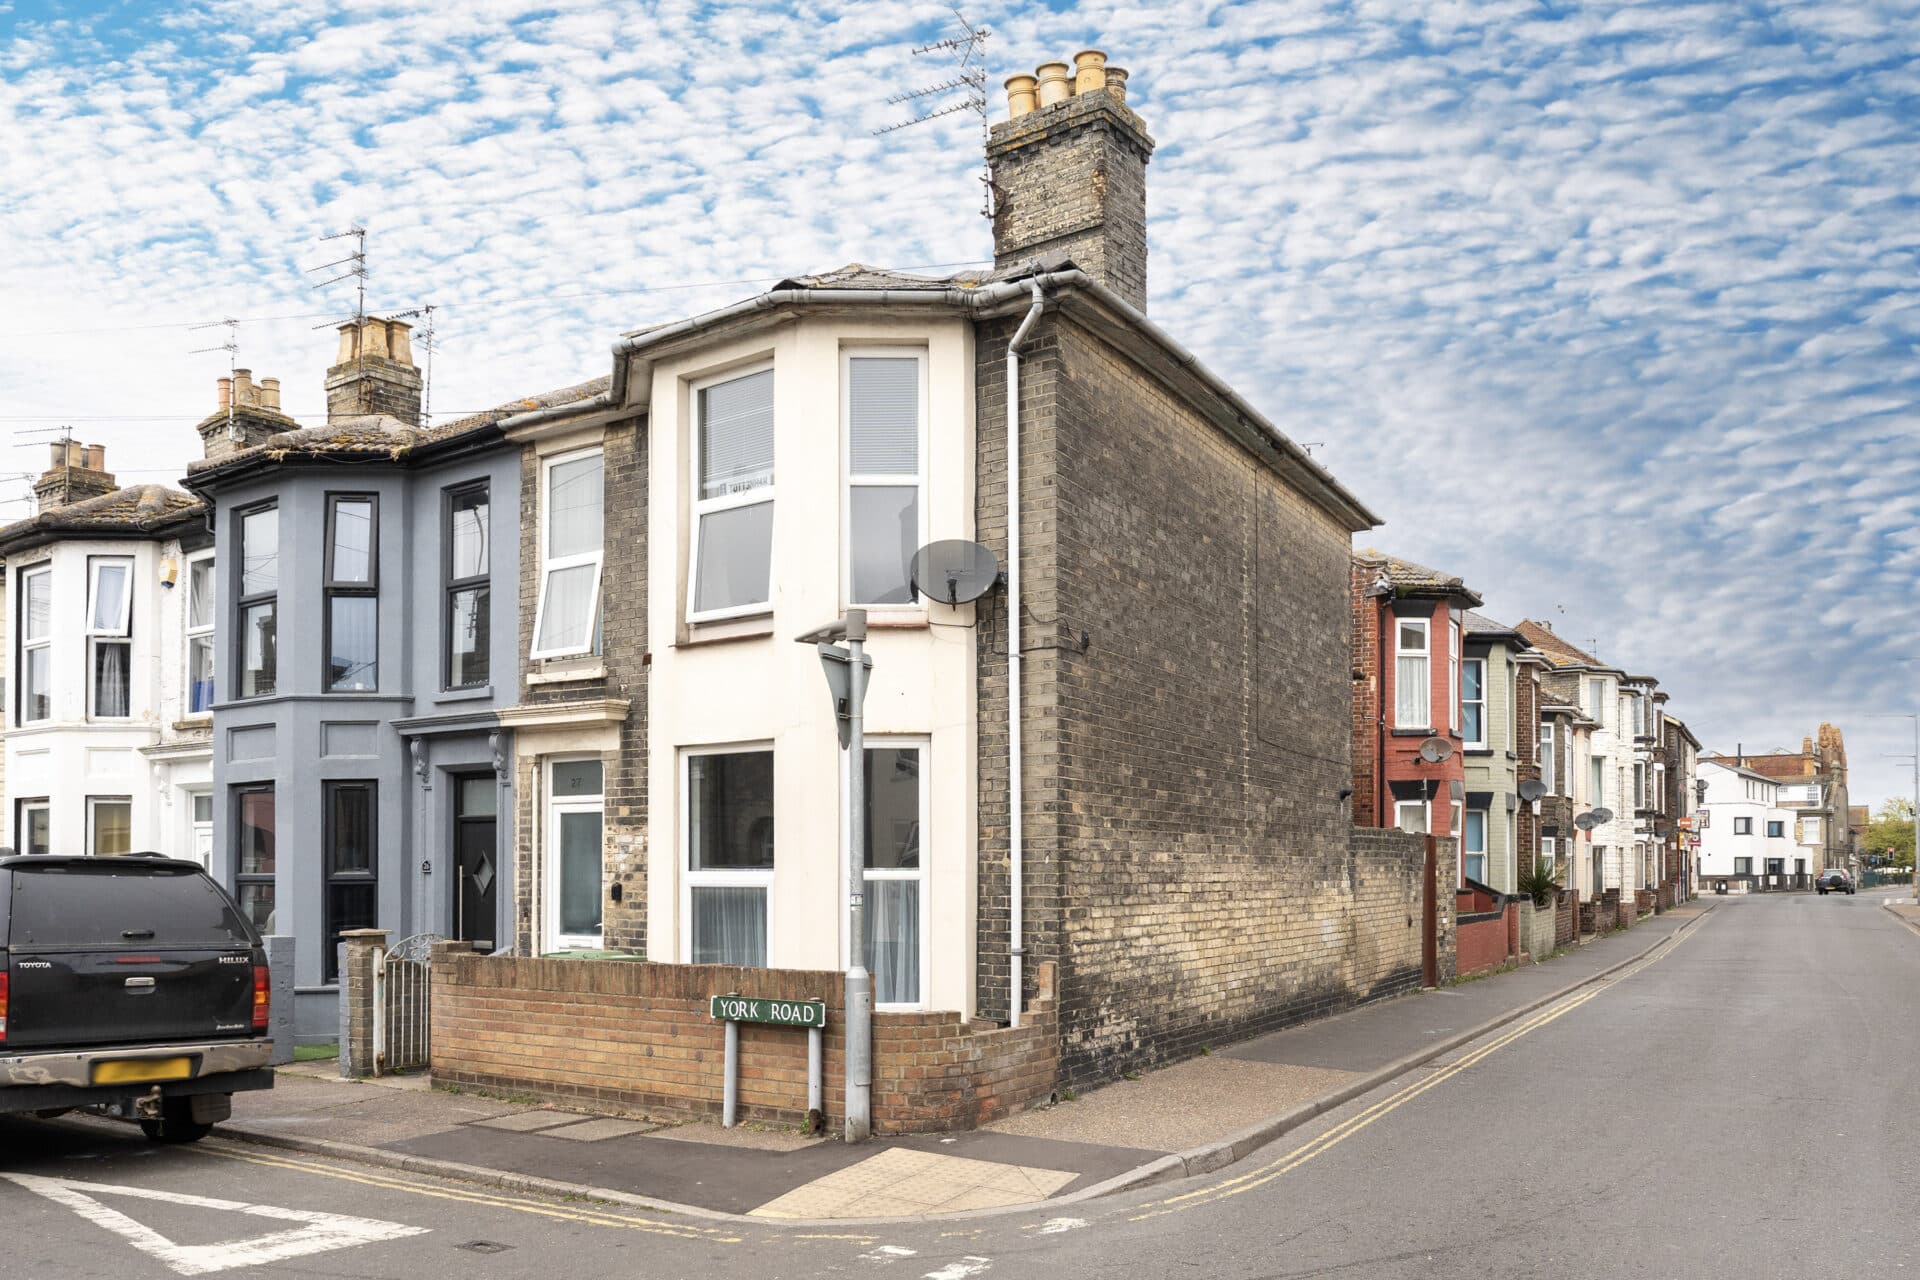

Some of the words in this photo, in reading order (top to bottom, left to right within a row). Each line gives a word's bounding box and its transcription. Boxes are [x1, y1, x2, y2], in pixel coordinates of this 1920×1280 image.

[571, 777, 582, 788] 27
[218, 956, 249, 964] HILUX
[18, 961, 52, 969] TOYOTA
[719, 999, 759, 1018] YORK
[771, 1003, 815, 1023] ROAD
